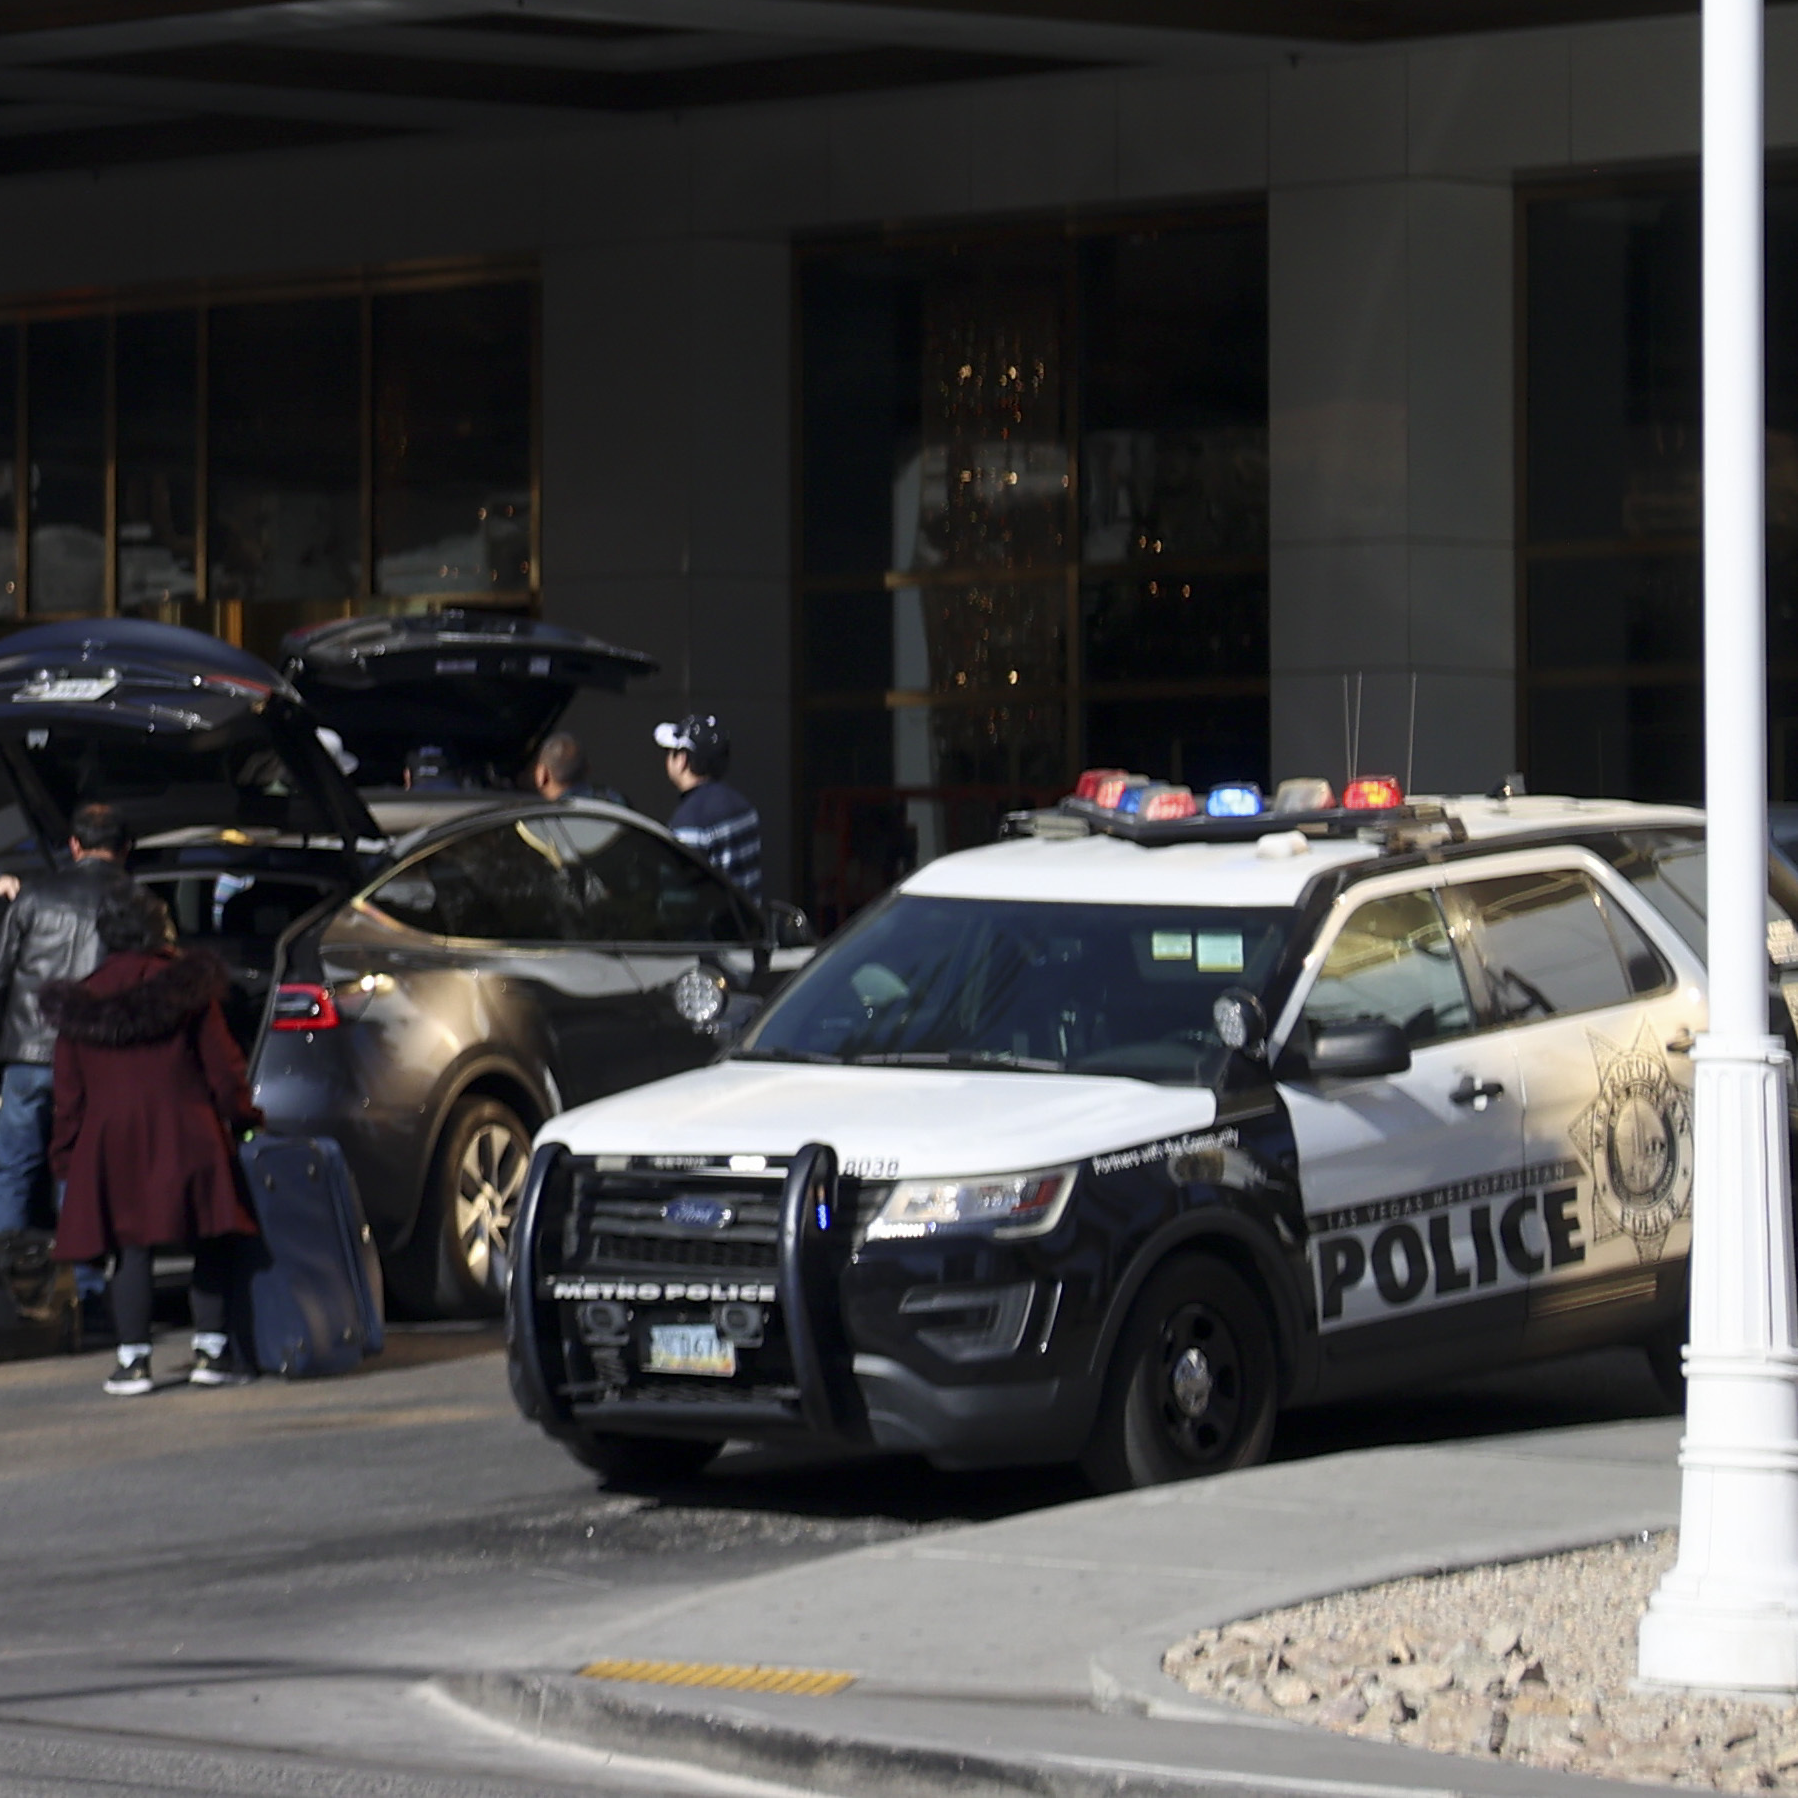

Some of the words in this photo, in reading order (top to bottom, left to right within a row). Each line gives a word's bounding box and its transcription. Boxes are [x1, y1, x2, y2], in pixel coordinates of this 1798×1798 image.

[1326, 1207, 1357, 1231] LAS
[1368, 1197, 1425, 1223] VEGAS
[1433, 1162, 1566, 1206] METROPOLITAN
[1318, 1186, 1587, 1321] POLICE
[554, 1282, 662, 1301] METRO
[665, 1283, 776, 1302] POLICE
